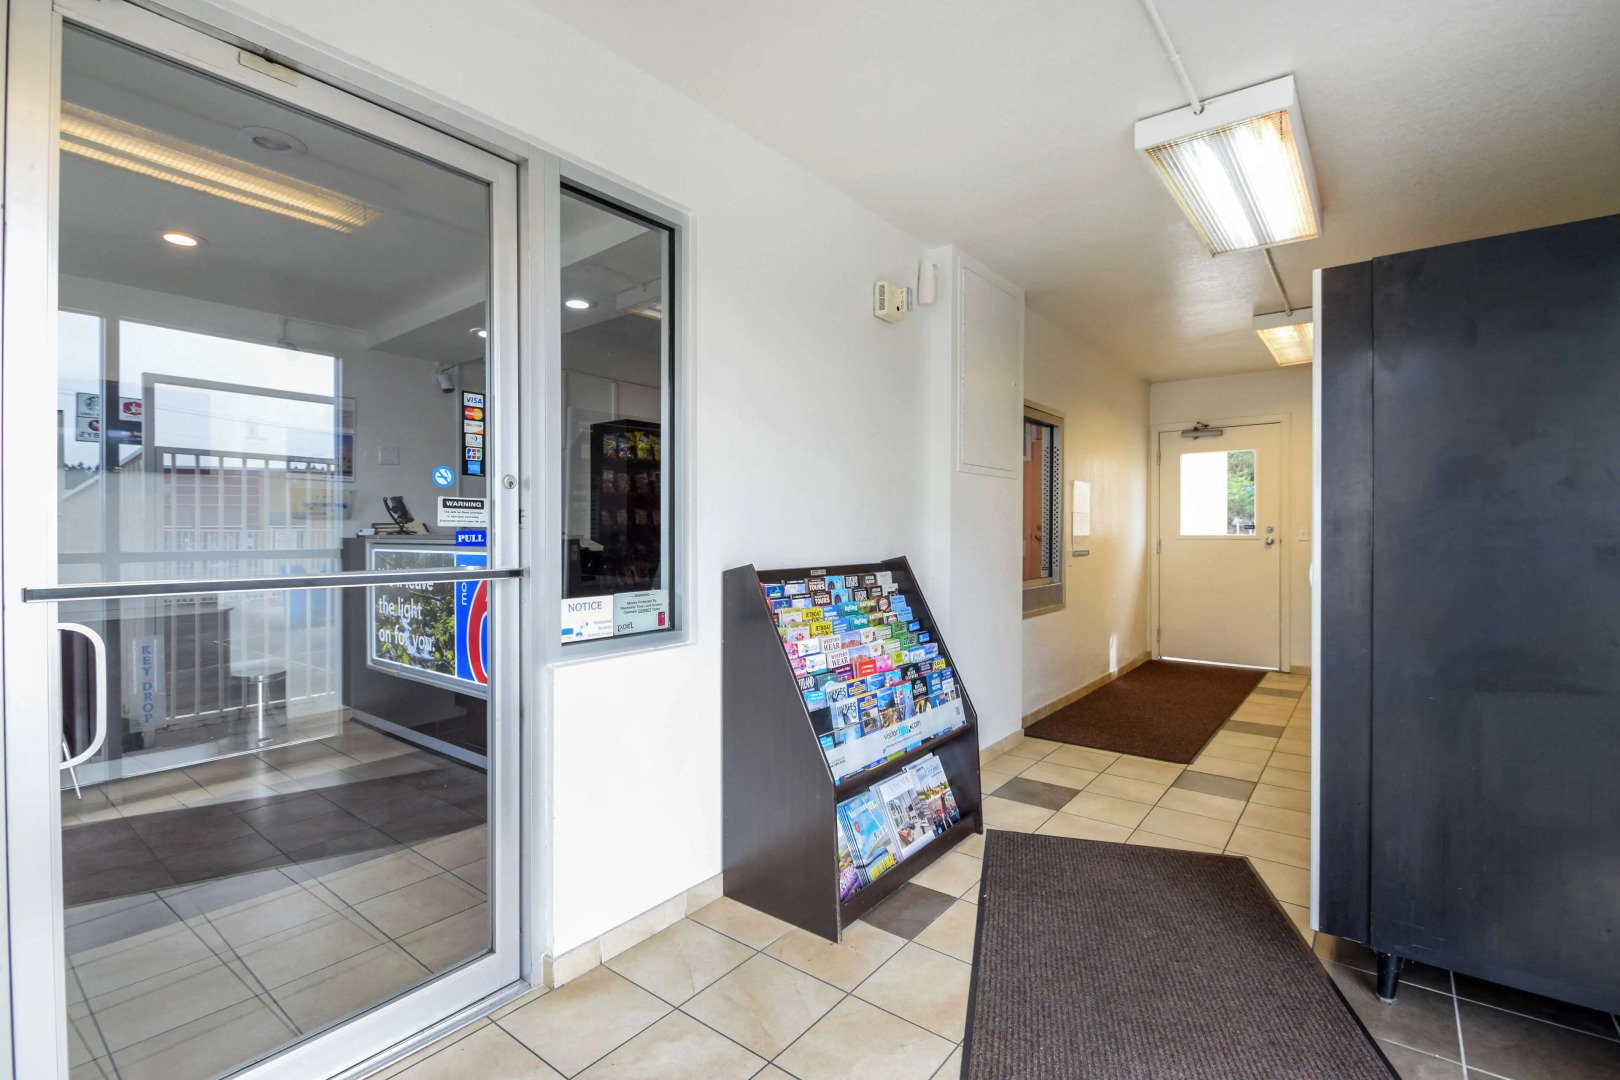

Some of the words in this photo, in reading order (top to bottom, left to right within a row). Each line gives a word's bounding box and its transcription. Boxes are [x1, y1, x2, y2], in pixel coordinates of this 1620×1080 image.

[466, 396, 482, 405] VISA
[445, 500, 482, 508] WARNING
[457, 534, 484, 543] PULL
[378, 594, 395, 614] the
[397, 596, 422, 623] light
[568, 600, 602, 612] NOTICE
[378, 628, 391, 642] on
[393, 624, 410, 646] for
[824, 642, 840, 652] WEAR
[142, 645, 152, 676] KEY
[832, 657, 848, 667] WEAR
[143, 682, 154, 724] DROP
